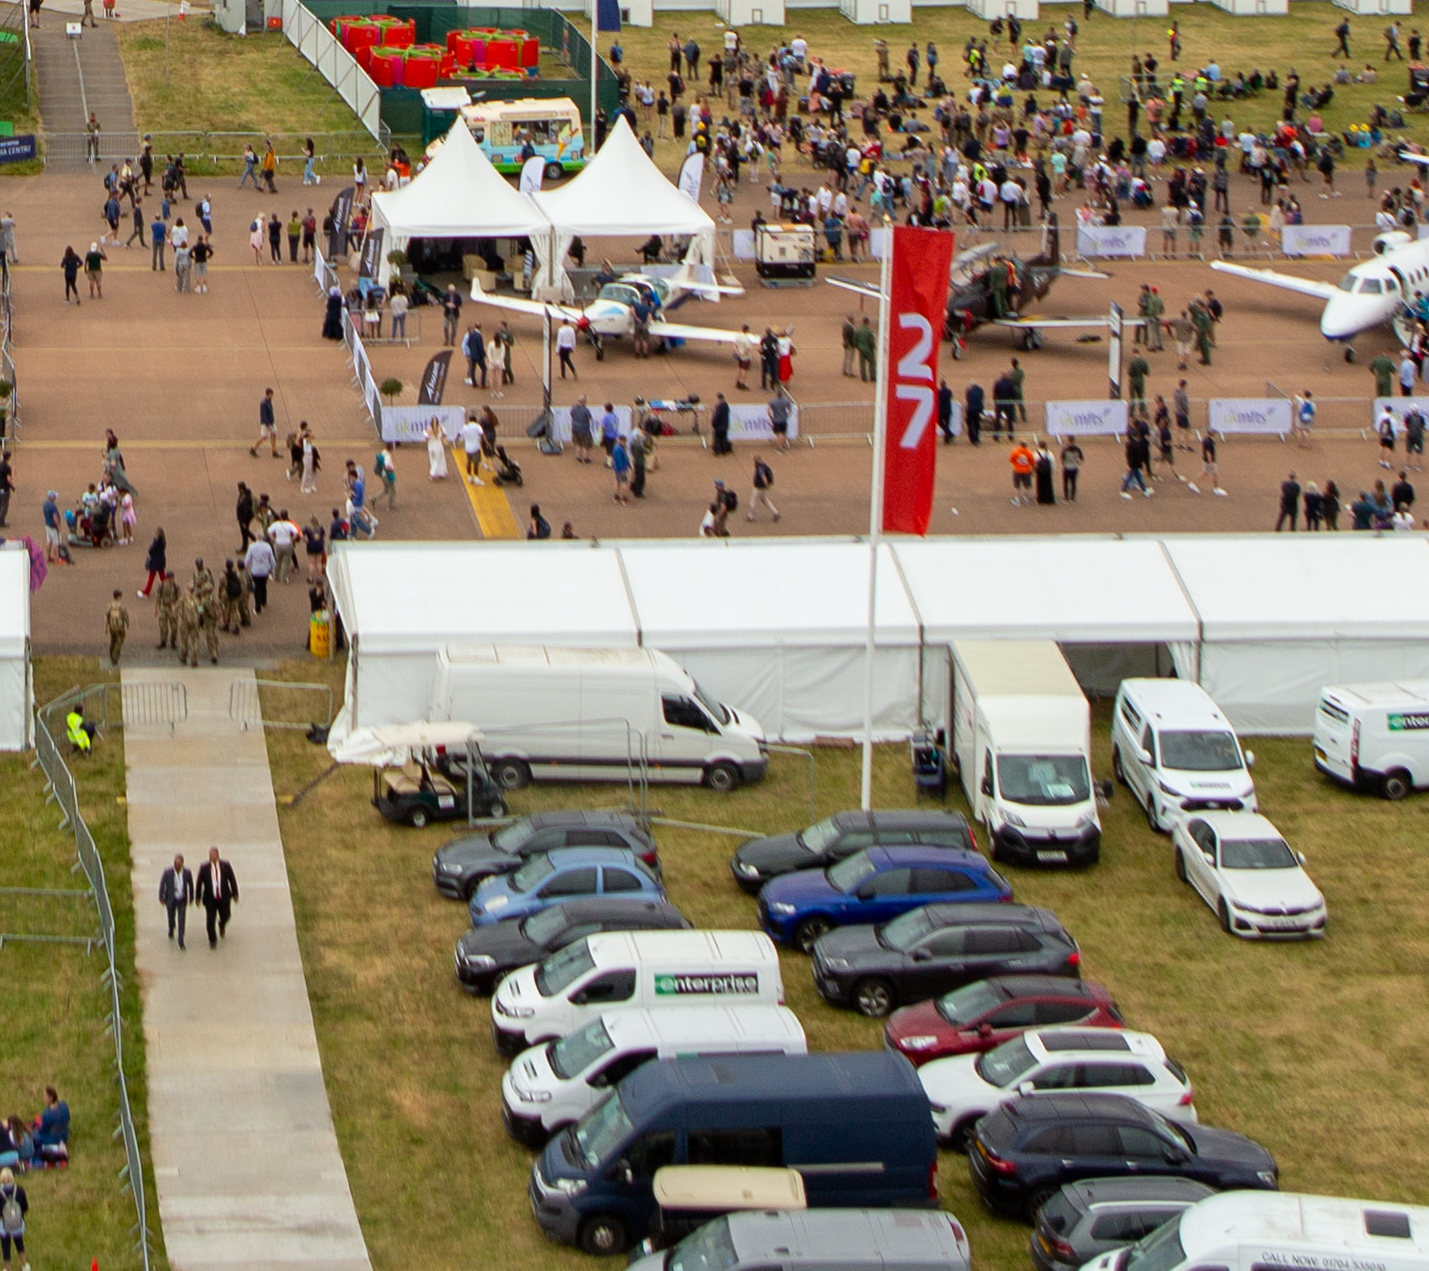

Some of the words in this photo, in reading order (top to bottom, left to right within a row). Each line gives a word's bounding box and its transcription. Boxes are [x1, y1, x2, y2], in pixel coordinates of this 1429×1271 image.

[895, 312, 935, 450] 27
[659, 973, 757, 993] enterprise
[1261, 1251, 1289, 1264] CALL
